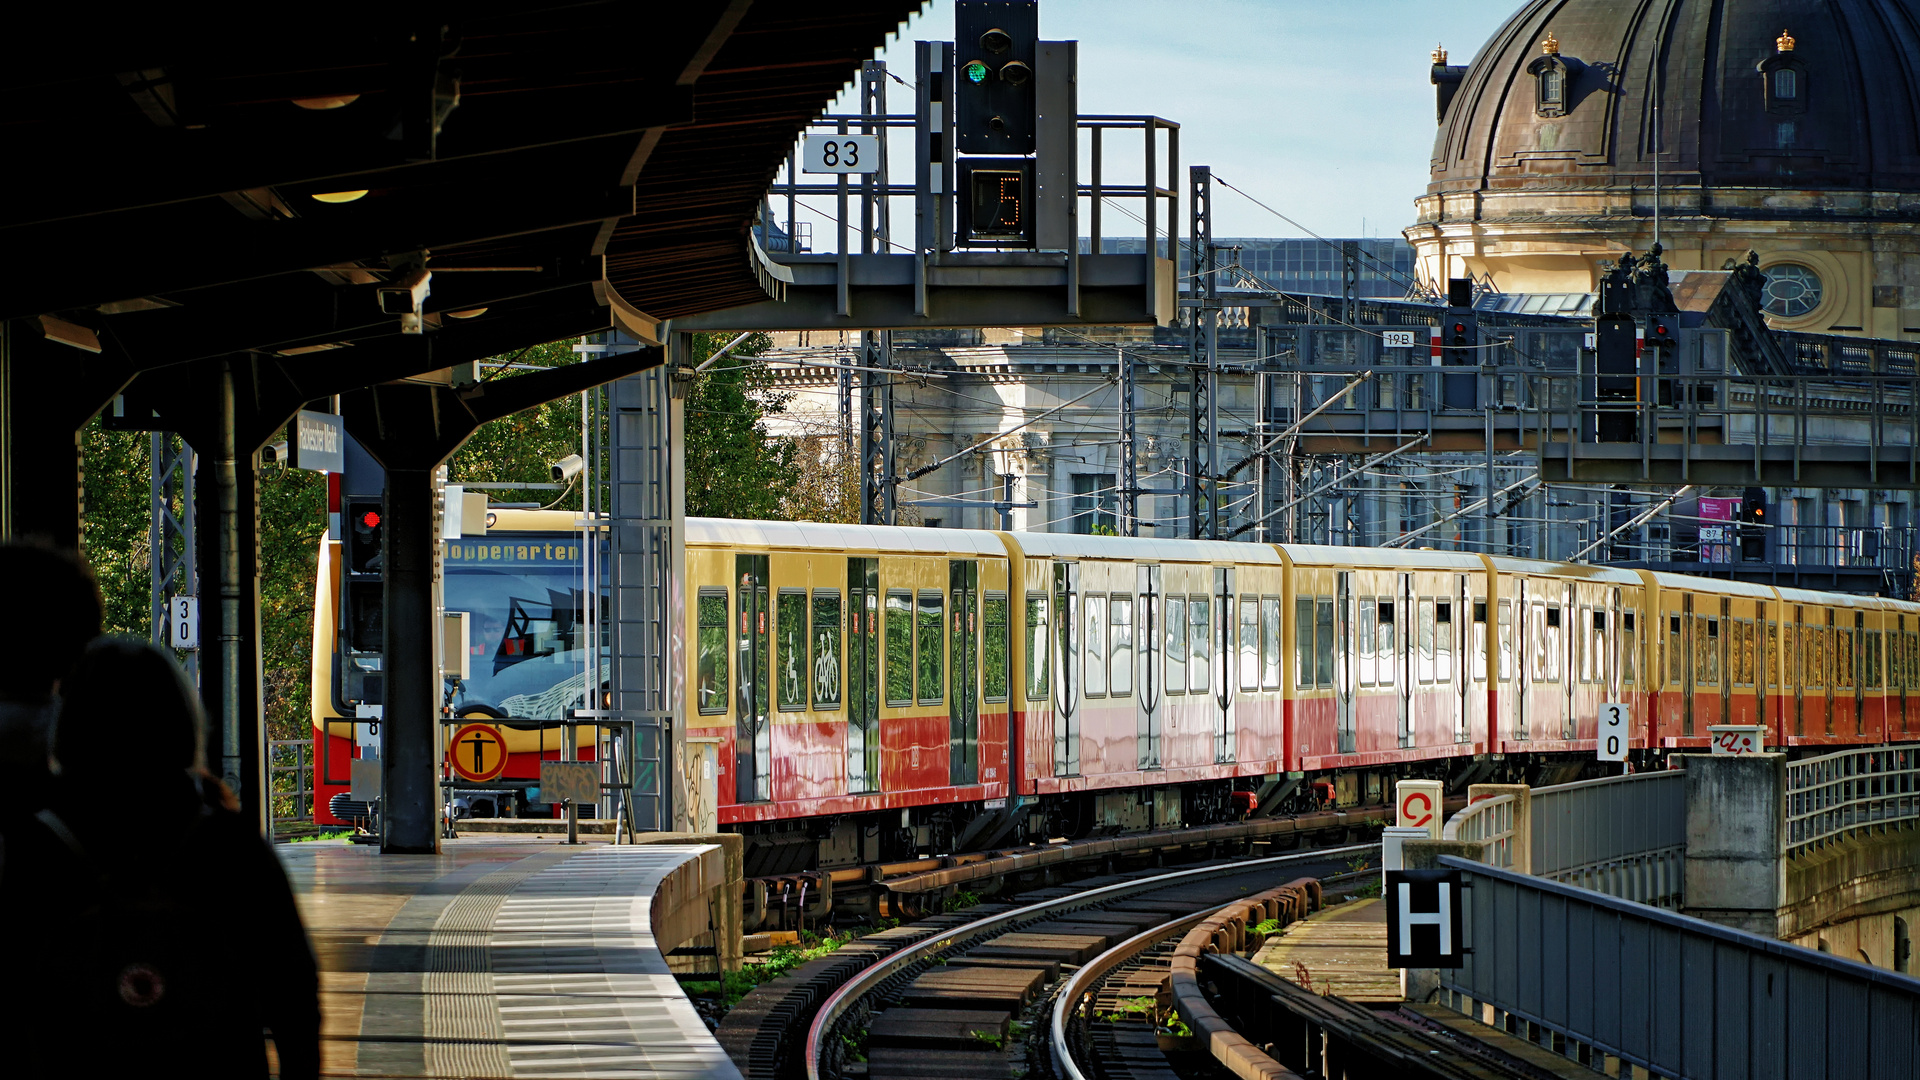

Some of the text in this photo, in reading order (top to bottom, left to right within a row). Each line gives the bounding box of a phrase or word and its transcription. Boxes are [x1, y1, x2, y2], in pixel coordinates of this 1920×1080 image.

[823, 140, 858, 167] 83
[1000, 177, 1019, 225] 5
[1388, 334, 1409, 345] 19B
[324, 423, 337, 453] Markt
[1706, 529, 1717, 538] 87
[369, 715, 378, 736] 8
[1398, 882, 1452, 955] H
